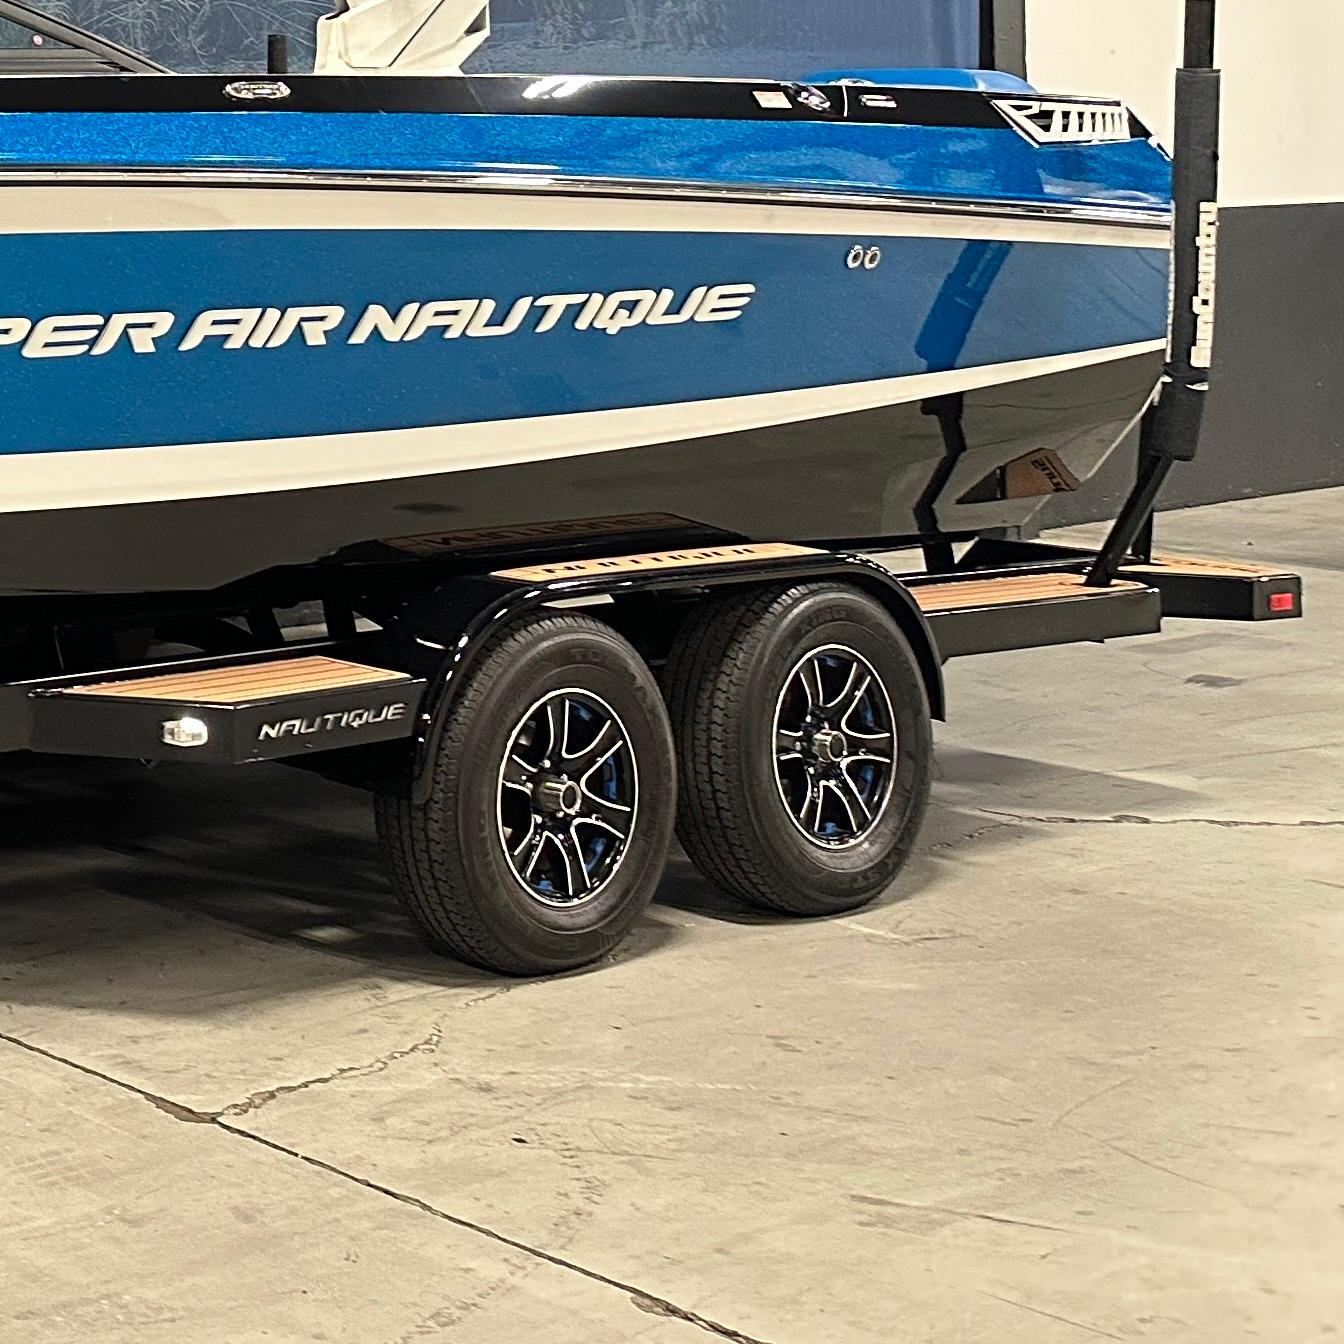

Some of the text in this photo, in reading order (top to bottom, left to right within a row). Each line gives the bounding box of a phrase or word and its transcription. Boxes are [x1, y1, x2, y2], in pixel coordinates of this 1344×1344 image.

[177, 305, 346, 352] AIR
[346, 282, 756, 345] NAUTIQUE
[257, 702, 407, 741] NAUTIQUE
